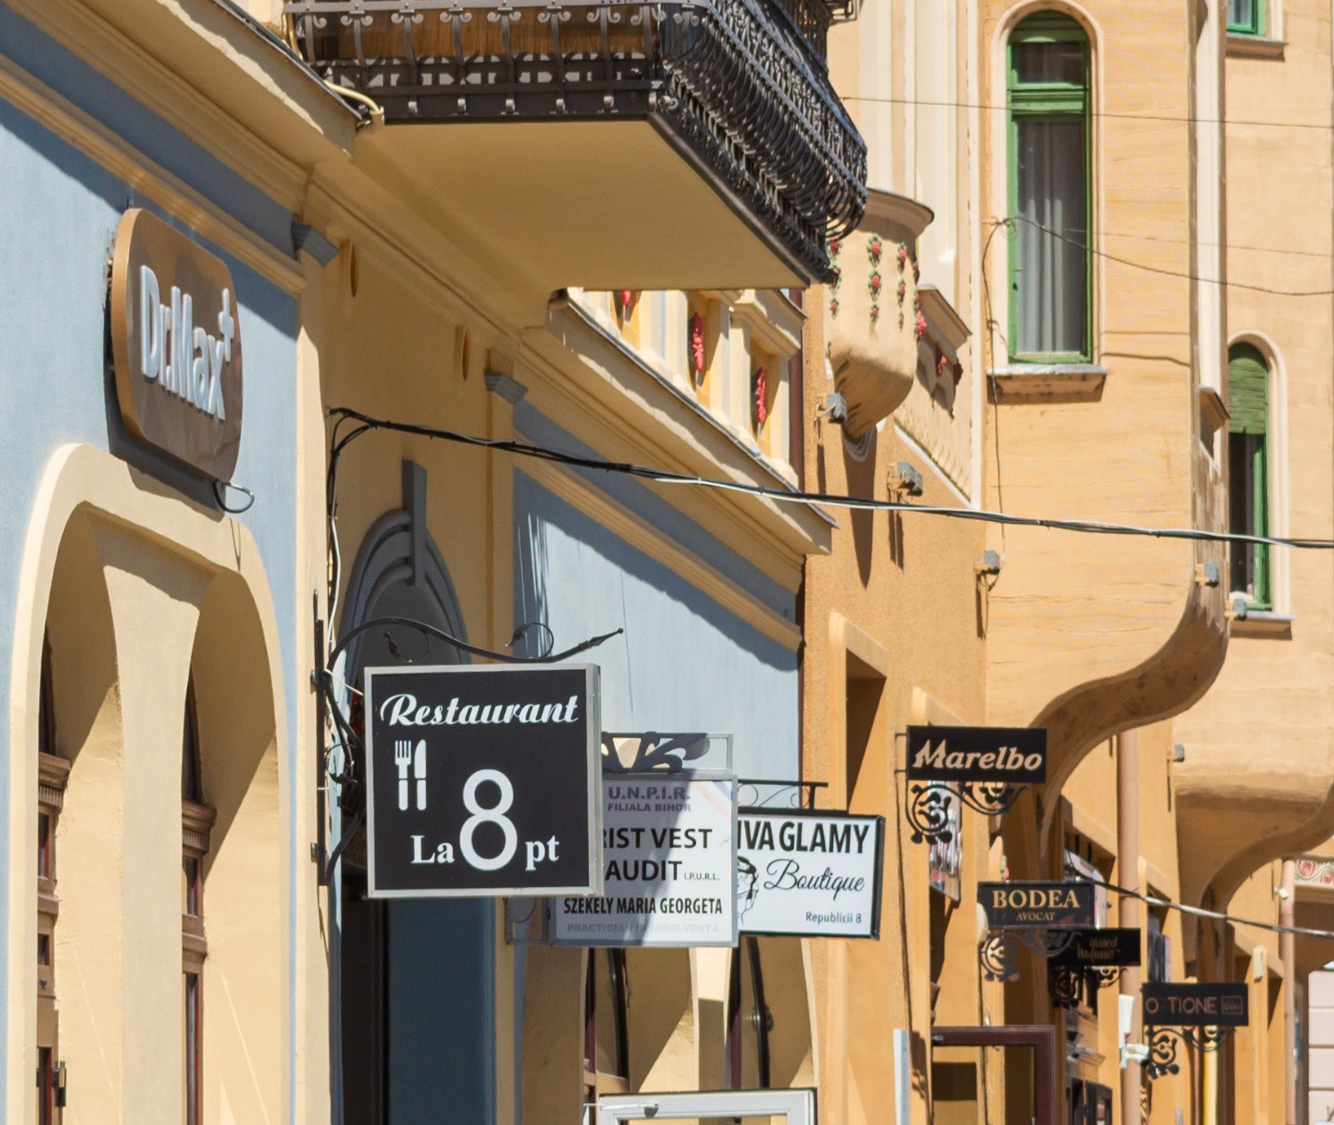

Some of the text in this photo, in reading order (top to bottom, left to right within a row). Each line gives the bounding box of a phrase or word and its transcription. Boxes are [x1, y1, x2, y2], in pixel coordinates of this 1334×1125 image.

[380, 694, 578, 726] Restaurant
[912, 739, 1043, 770] Marelbo
[608, 786, 691, 800] U.N.P.I.R.
[607, 803, 691, 812] FILIALA BIHOR
[410, 769, 560, 871] La 8 pt
[650, 828, 713, 849] VEST
[779, 821, 870, 854] GLAMY
[605, 860, 720, 881] AUDIT I.P.U.R.L.
[763, 858, 866, 901] Boutique
[564, 898, 723, 914] SZEKELY MARIA GEORGETA
[992, 889, 1081, 909] BODEA
[805, 911, 862, 925] Republicii 8
[1016, 912, 1056, 921] AVOCAT
